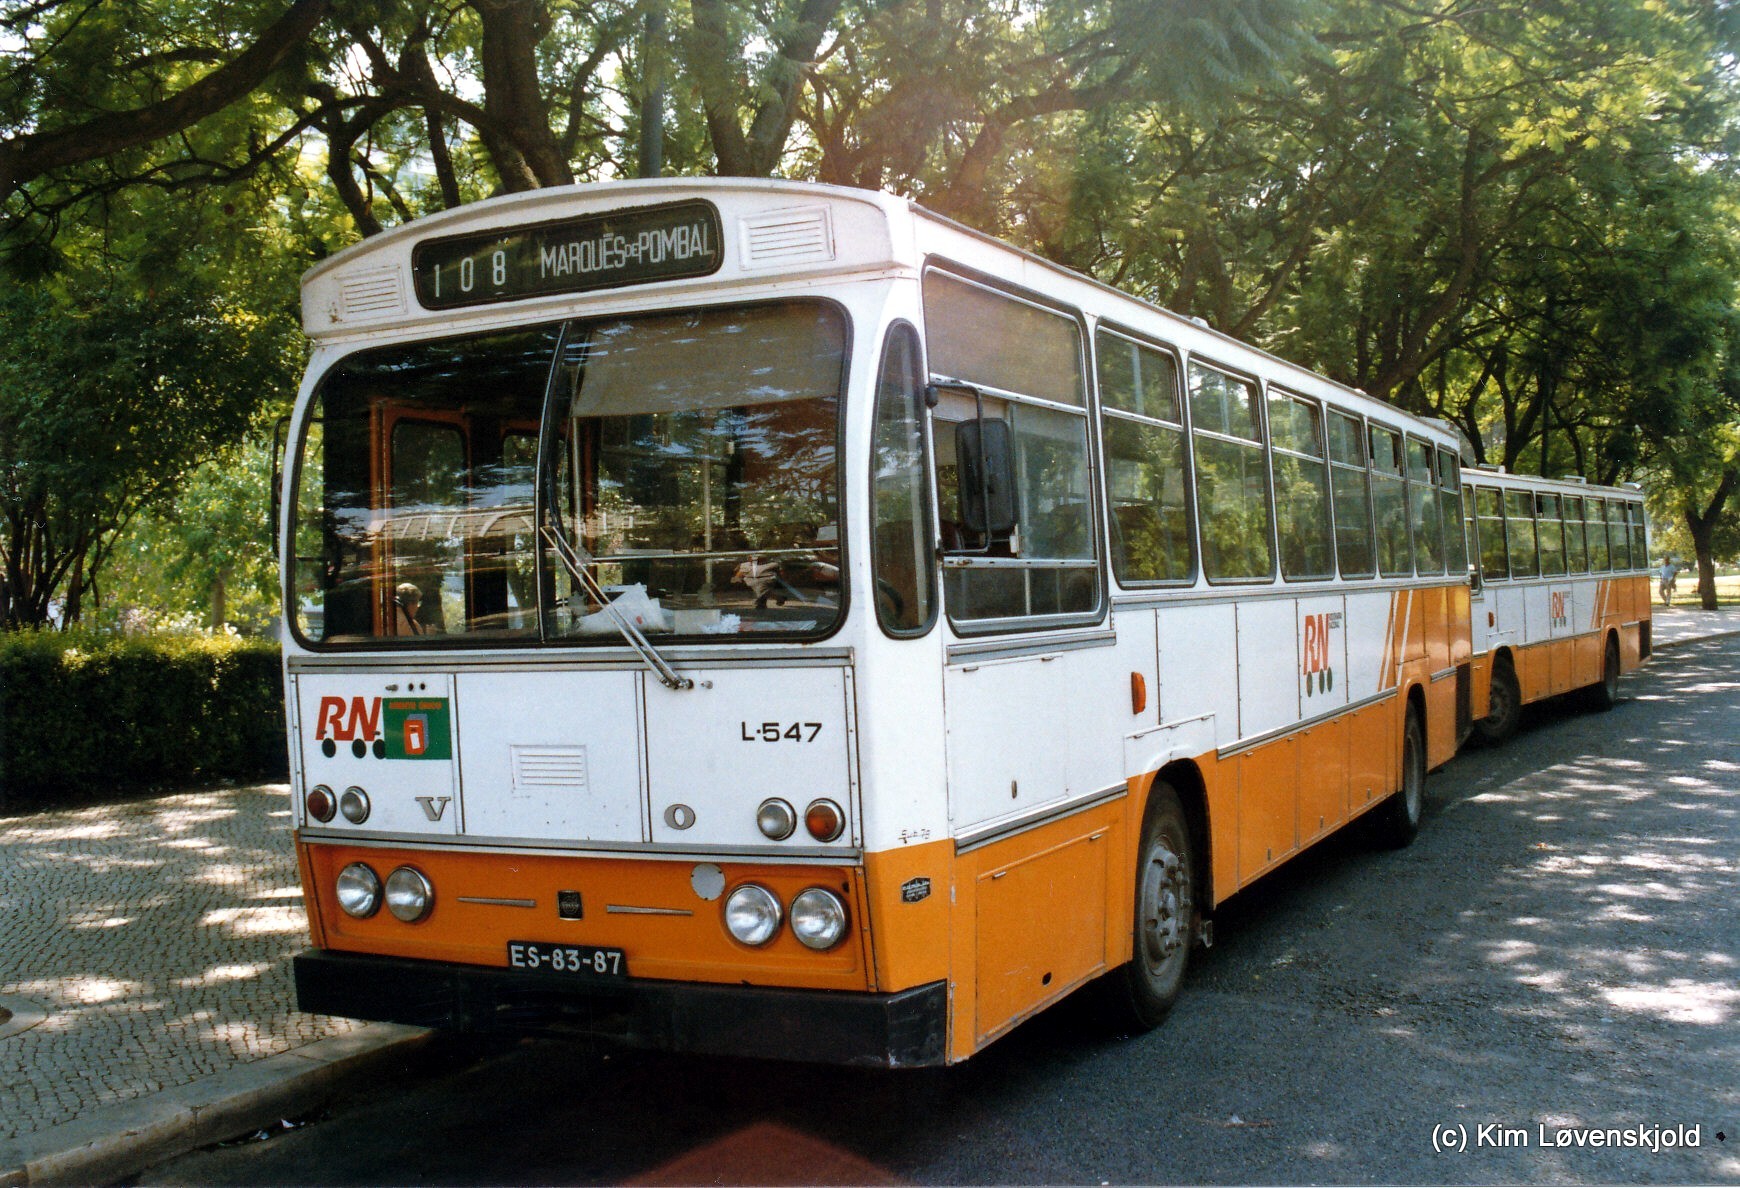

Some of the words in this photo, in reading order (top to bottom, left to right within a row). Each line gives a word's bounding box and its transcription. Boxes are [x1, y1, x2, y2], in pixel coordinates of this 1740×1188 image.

[638, 222, 716, 265] POMBAL
[1303, 613, 1329, 675] RN
[315, 696, 382, 741] RN
[415, 796, 452, 822] V
[510, 945, 621, 975] ES-83-87
